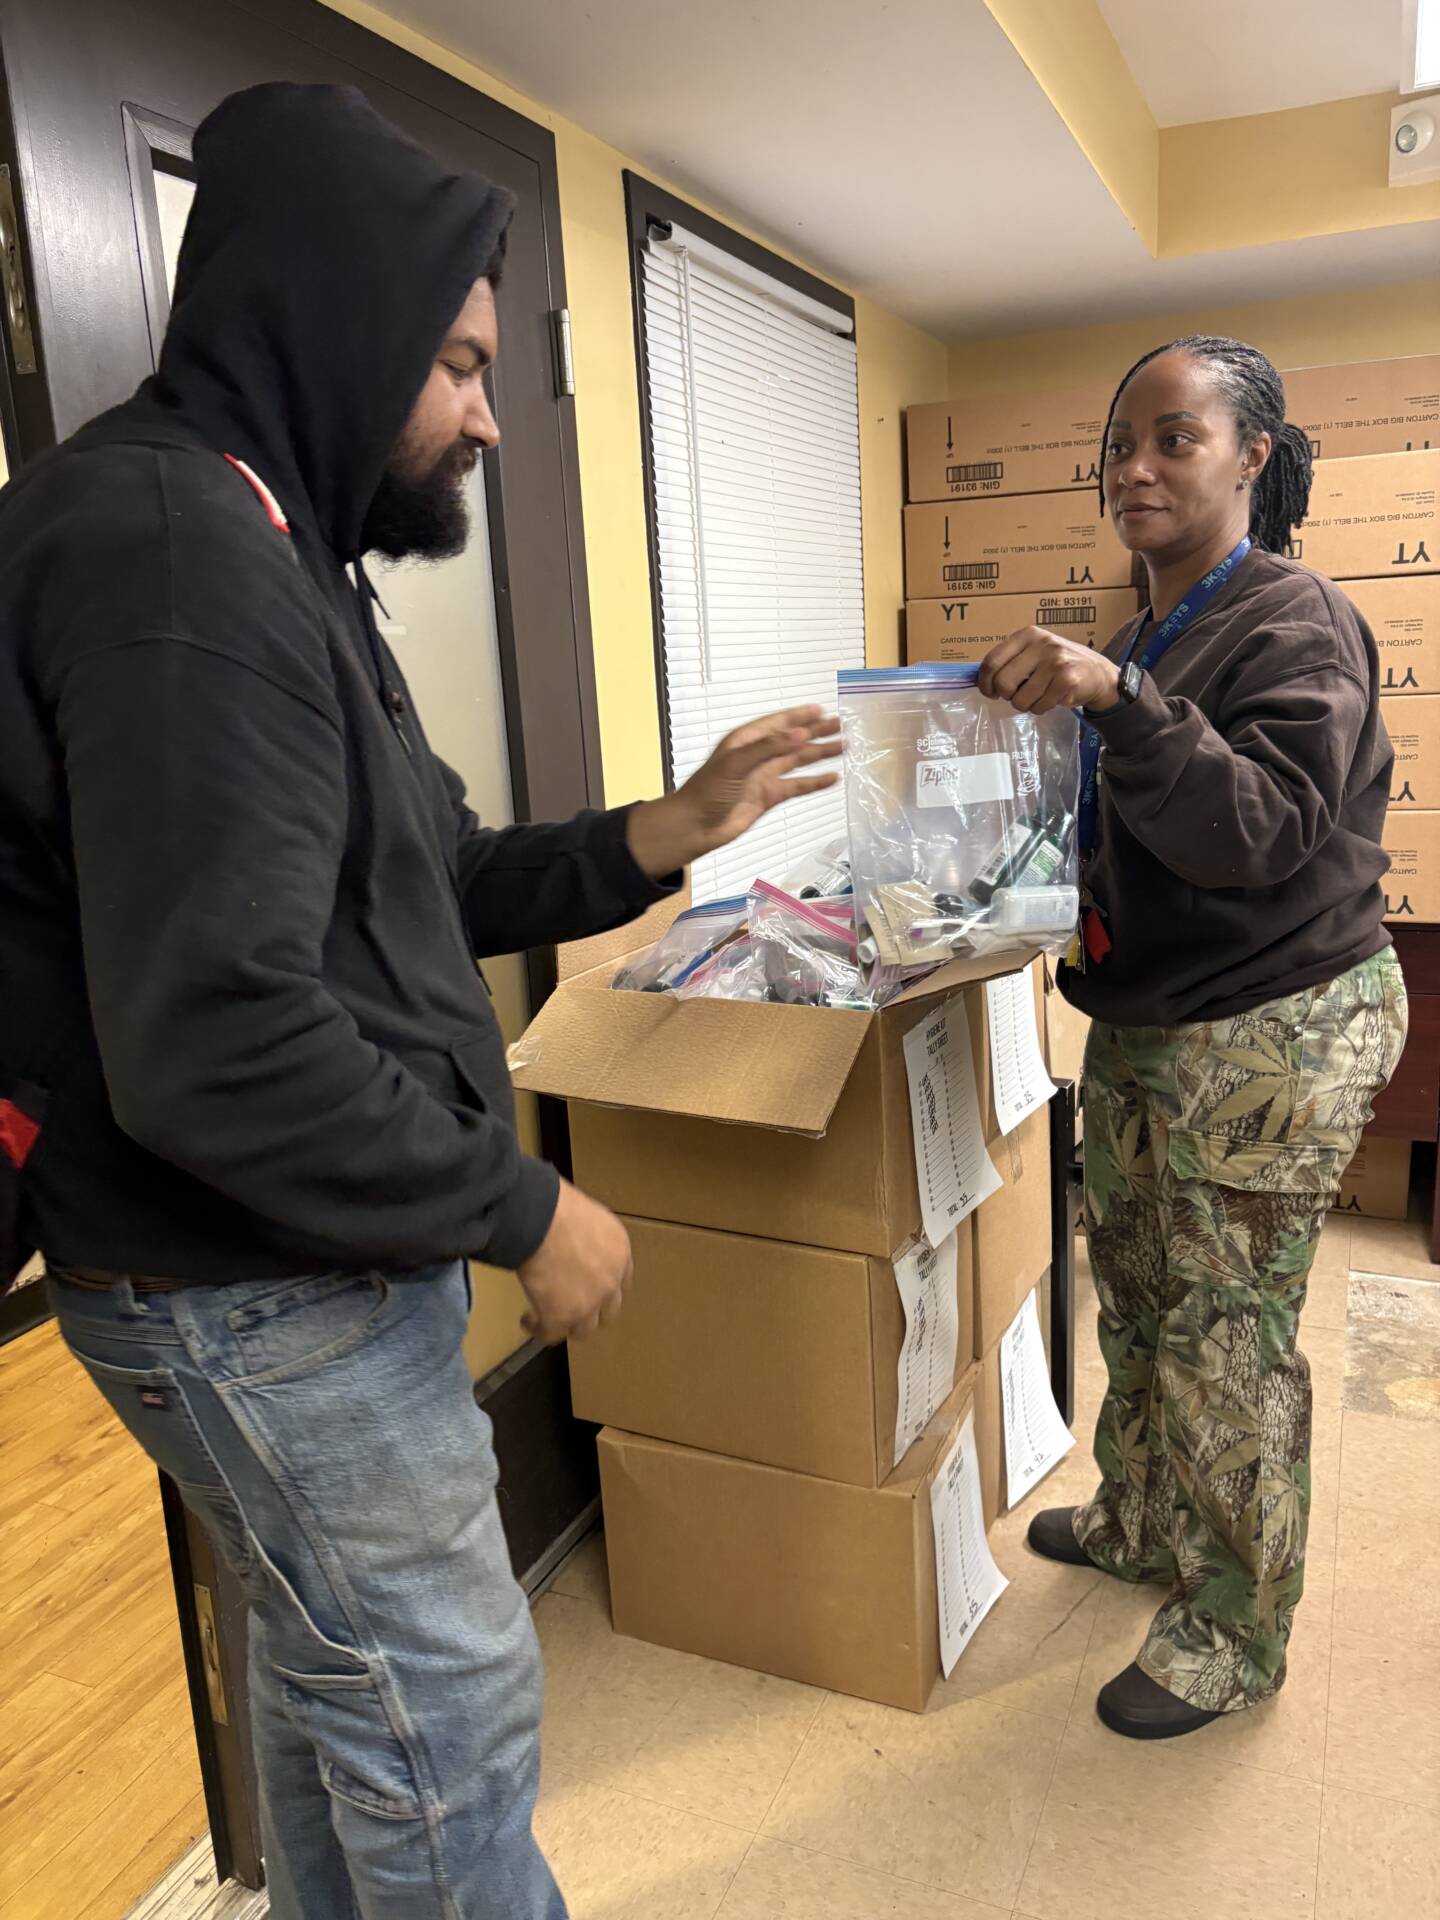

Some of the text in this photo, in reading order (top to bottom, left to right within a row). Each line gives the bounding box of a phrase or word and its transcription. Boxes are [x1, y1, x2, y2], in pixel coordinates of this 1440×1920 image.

[1372, 418, 1389, 426] BOX
[1390, 416, 1405, 424] BIG
[1406, 413, 1439, 423] CARTON
[1335, 420, 1354, 429] BELL
[1355, 420, 1370, 428] THE
[1071, 462, 1100, 482] YT
[950, 481, 1000, 493] GIN: 93191
[1352, 516, 1368, 524] THE
[1369, 514, 1386, 523] BOX
[1386, 513, 1401, 522] BIG
[1402, 511, 1435, 520] CARTON
[1333, 517, 1352, 526] BELL
[1010, 545, 1027, 553] BELL
[1026, 545, 1040, 553] THE
[1041, 544, 1055, 552] BOX
[1055, 543, 1068, 551] BIG
[1069, 542, 1096, 551] CARTON
[1391, 541, 1431, 565] YT
[1065, 566, 1094, 585] YT
[947, 580, 996, 592] GIN: 93191
[1039, 596, 1092, 608] GIN: 93191
[941, 602, 969, 621] YT
[940, 635, 967, 645] CARTON
[967, 635, 980, 644] BIG
[980, 634, 994, 643] BOX
[1386, 638, 1423, 648] CARTON
[1380, 667, 1419, 689] YT
[1393, 753, 1418, 761] CARTO
[1384, 894, 1415, 915] YT
